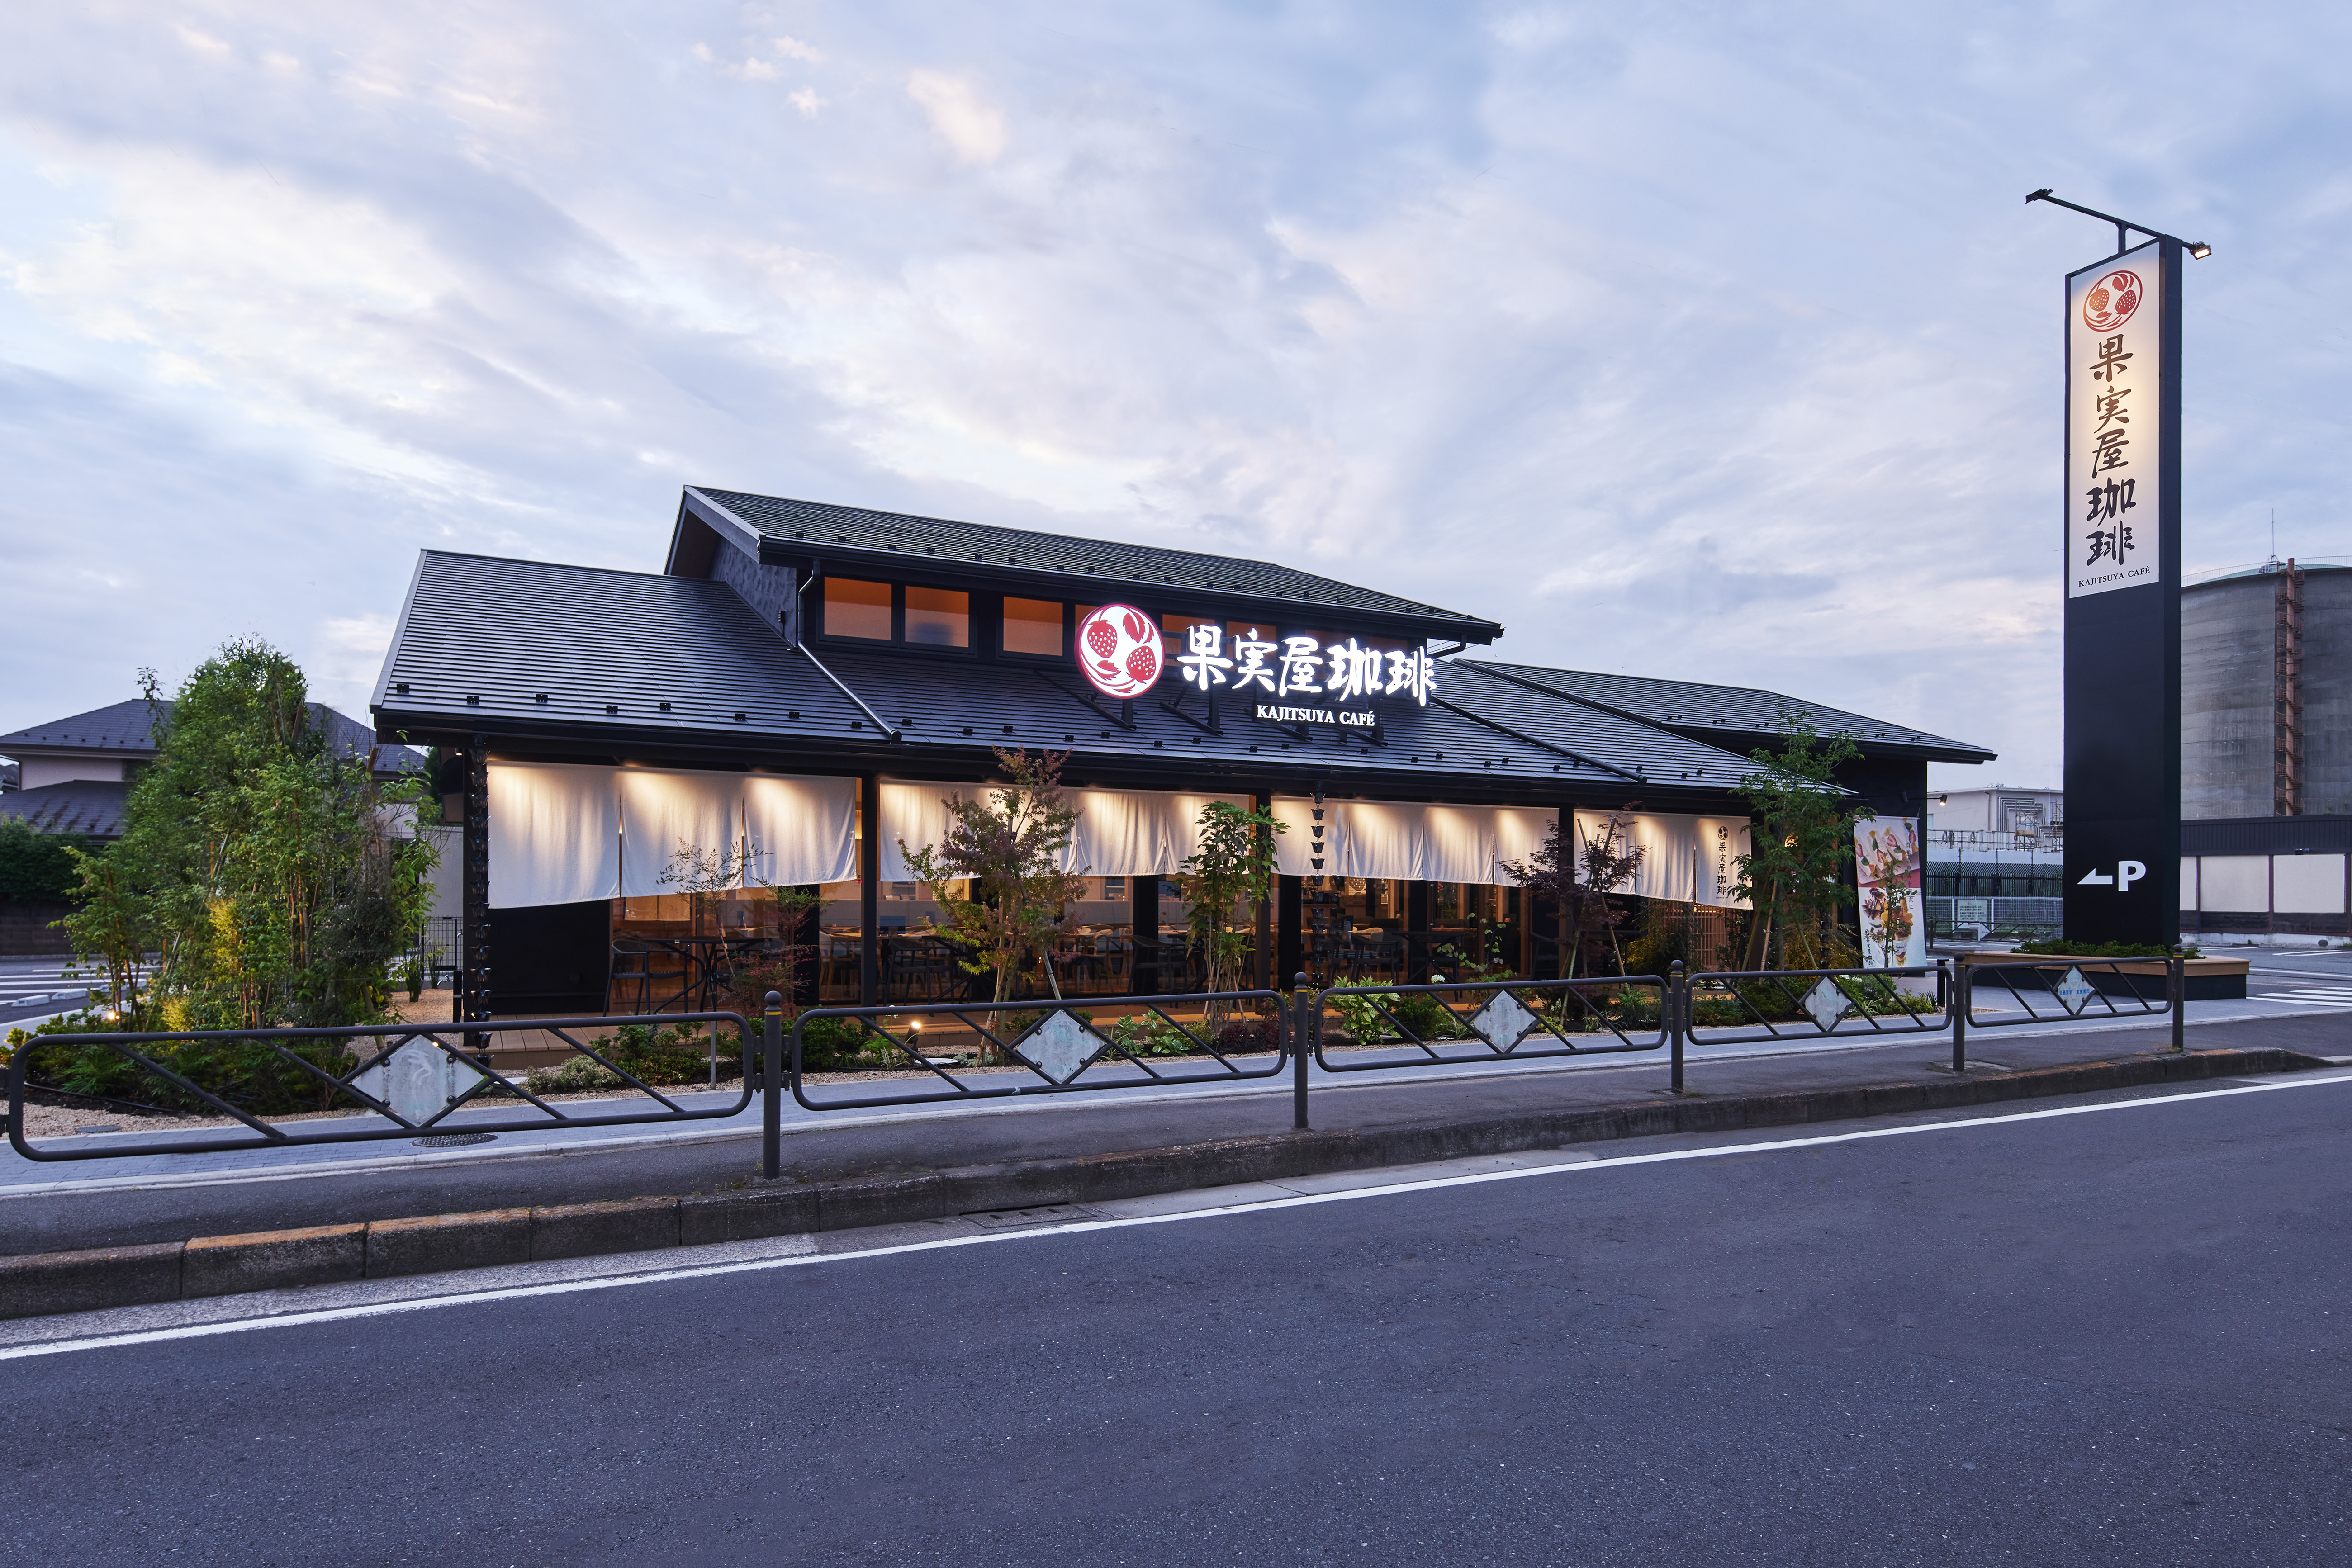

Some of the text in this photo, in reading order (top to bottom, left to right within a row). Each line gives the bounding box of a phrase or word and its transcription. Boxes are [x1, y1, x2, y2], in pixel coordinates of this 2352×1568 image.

[2086, 334, 2137, 566] 果実屋珈琲
[2078, 565, 2150, 587] KAJITSUYA CAFÉ
[1177, 625, 1437, 706] 果実屋珈琲
[1257, 705, 1375, 726] KAJITSUYA CAFÉ
[1717, 841, 1727, 895] 果実屋珈琲
[2118, 860, 2146, 891] P
